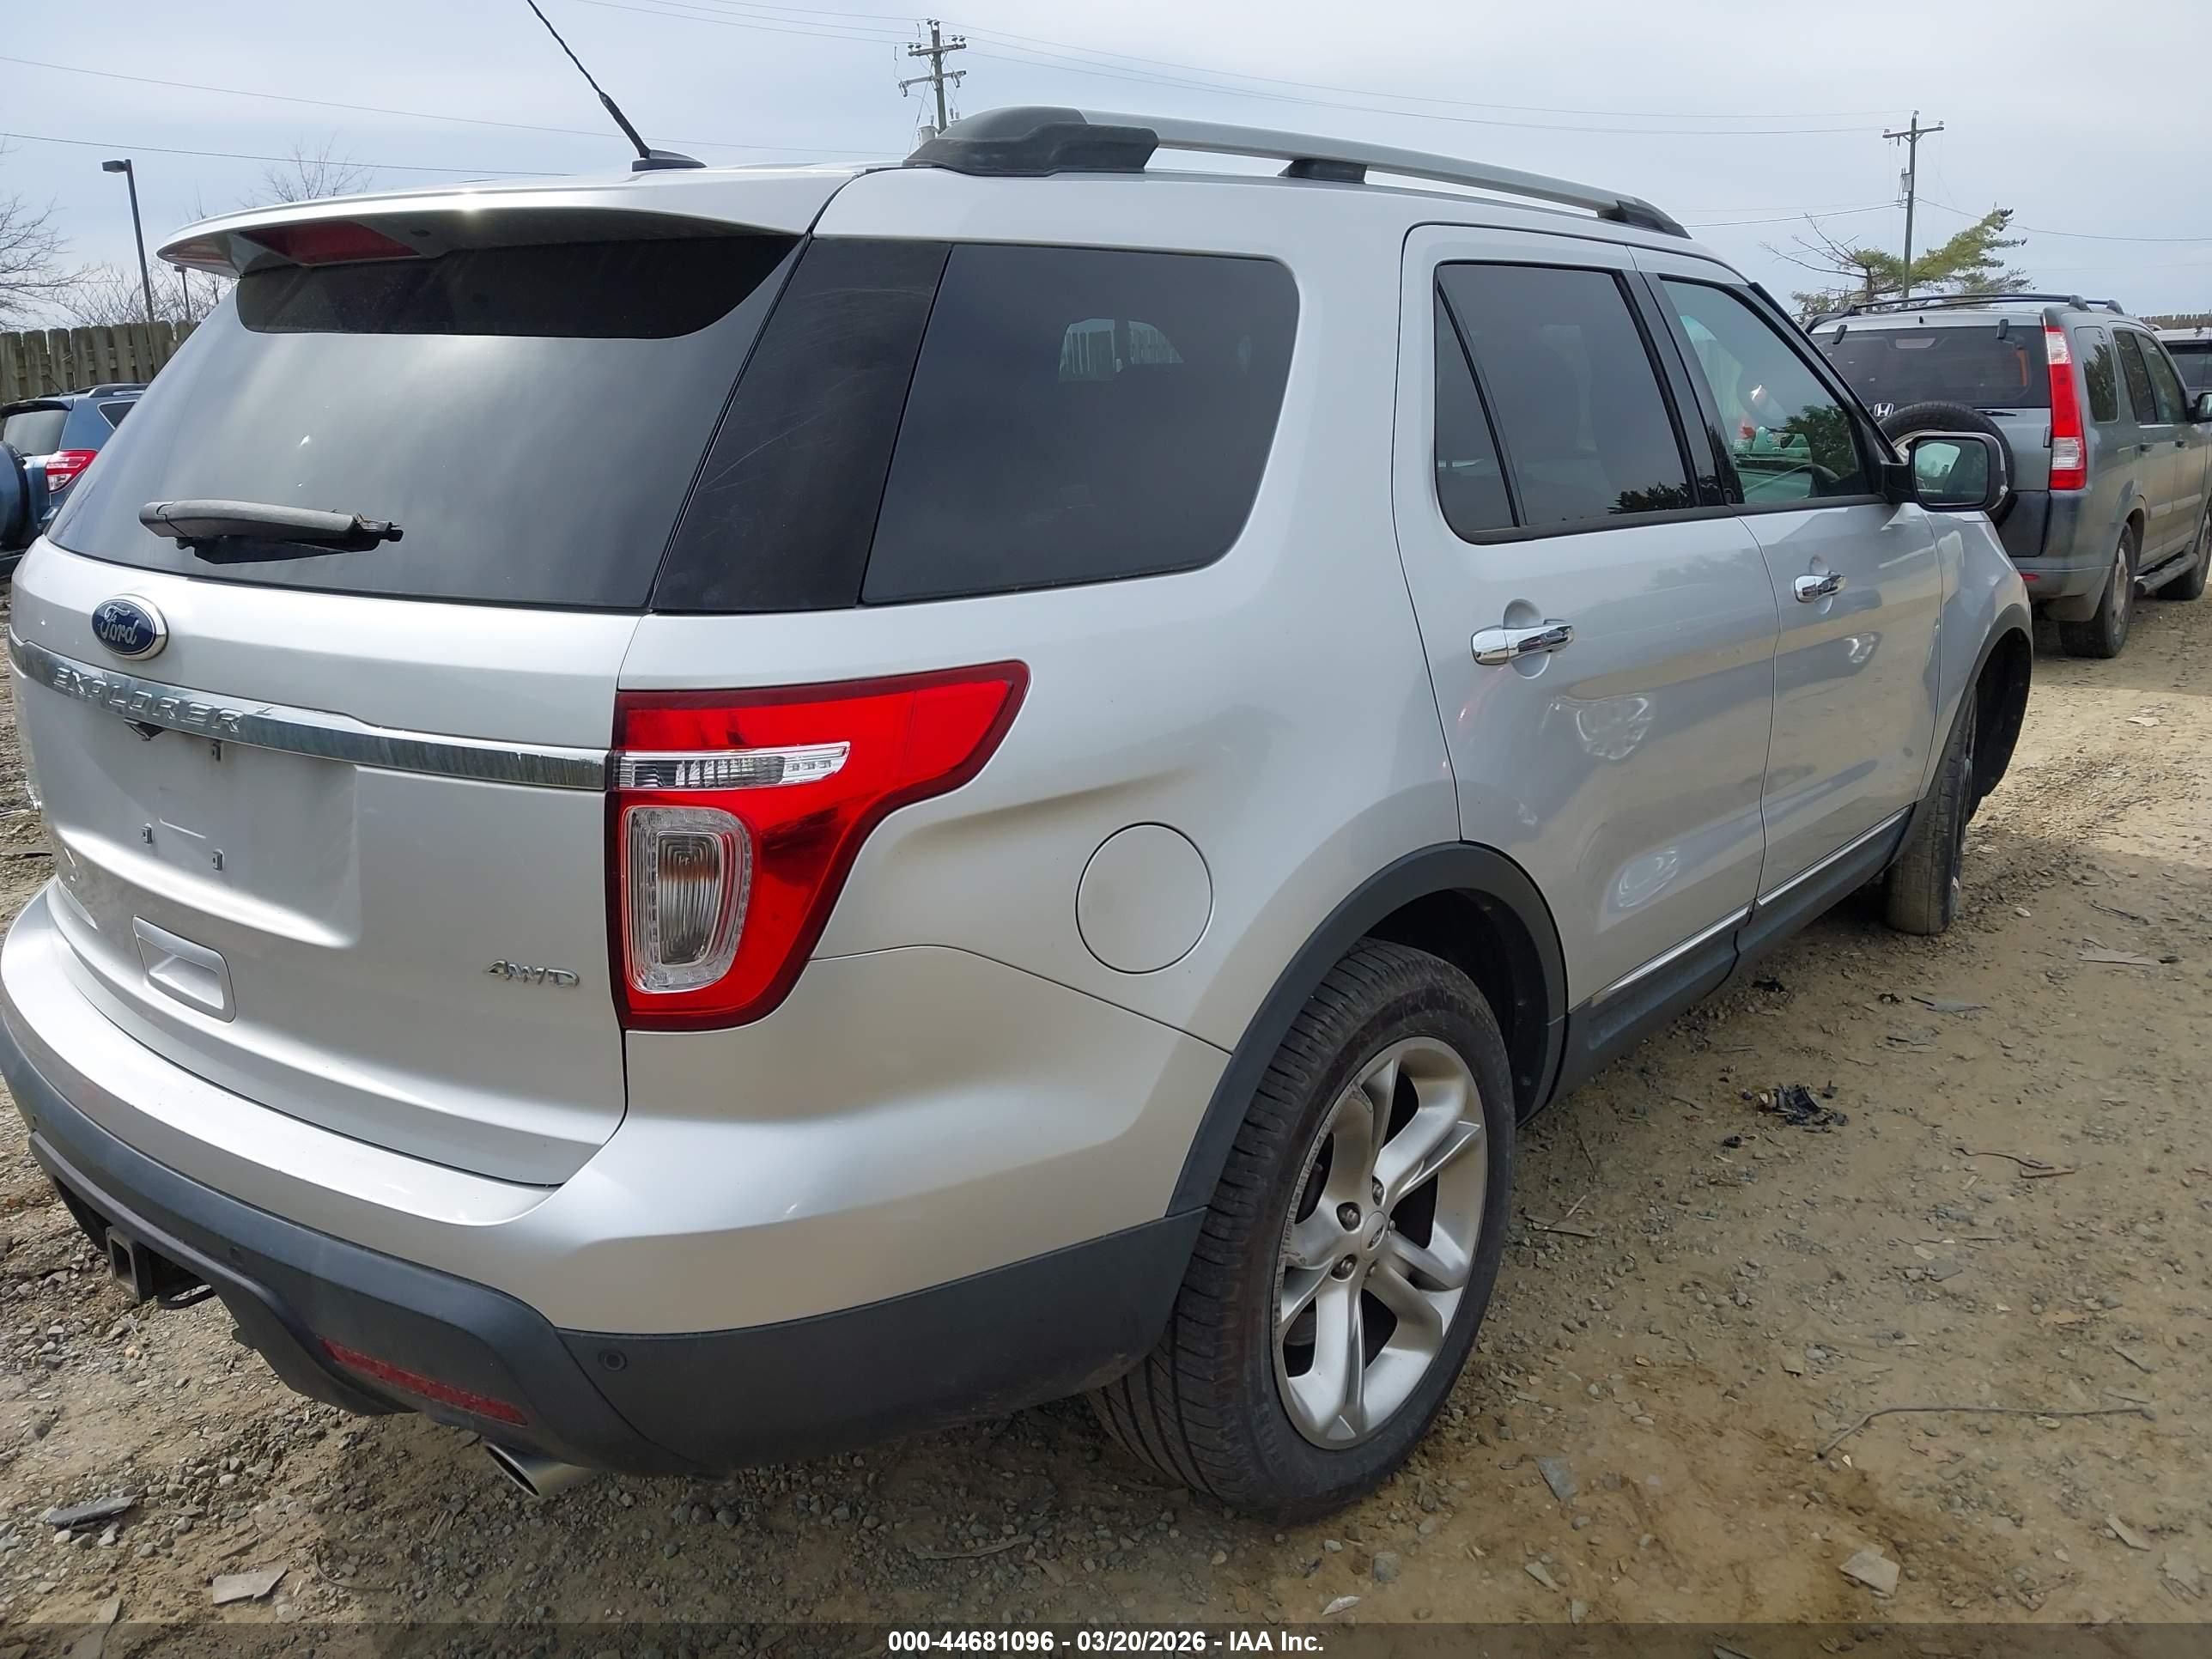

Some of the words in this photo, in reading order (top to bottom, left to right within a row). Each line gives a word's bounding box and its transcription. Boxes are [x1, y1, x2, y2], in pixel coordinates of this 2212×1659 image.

[100, 605, 139, 645] Ford
[53, 666, 245, 733] EXPLORER
[487, 959, 580, 988] 4WD
